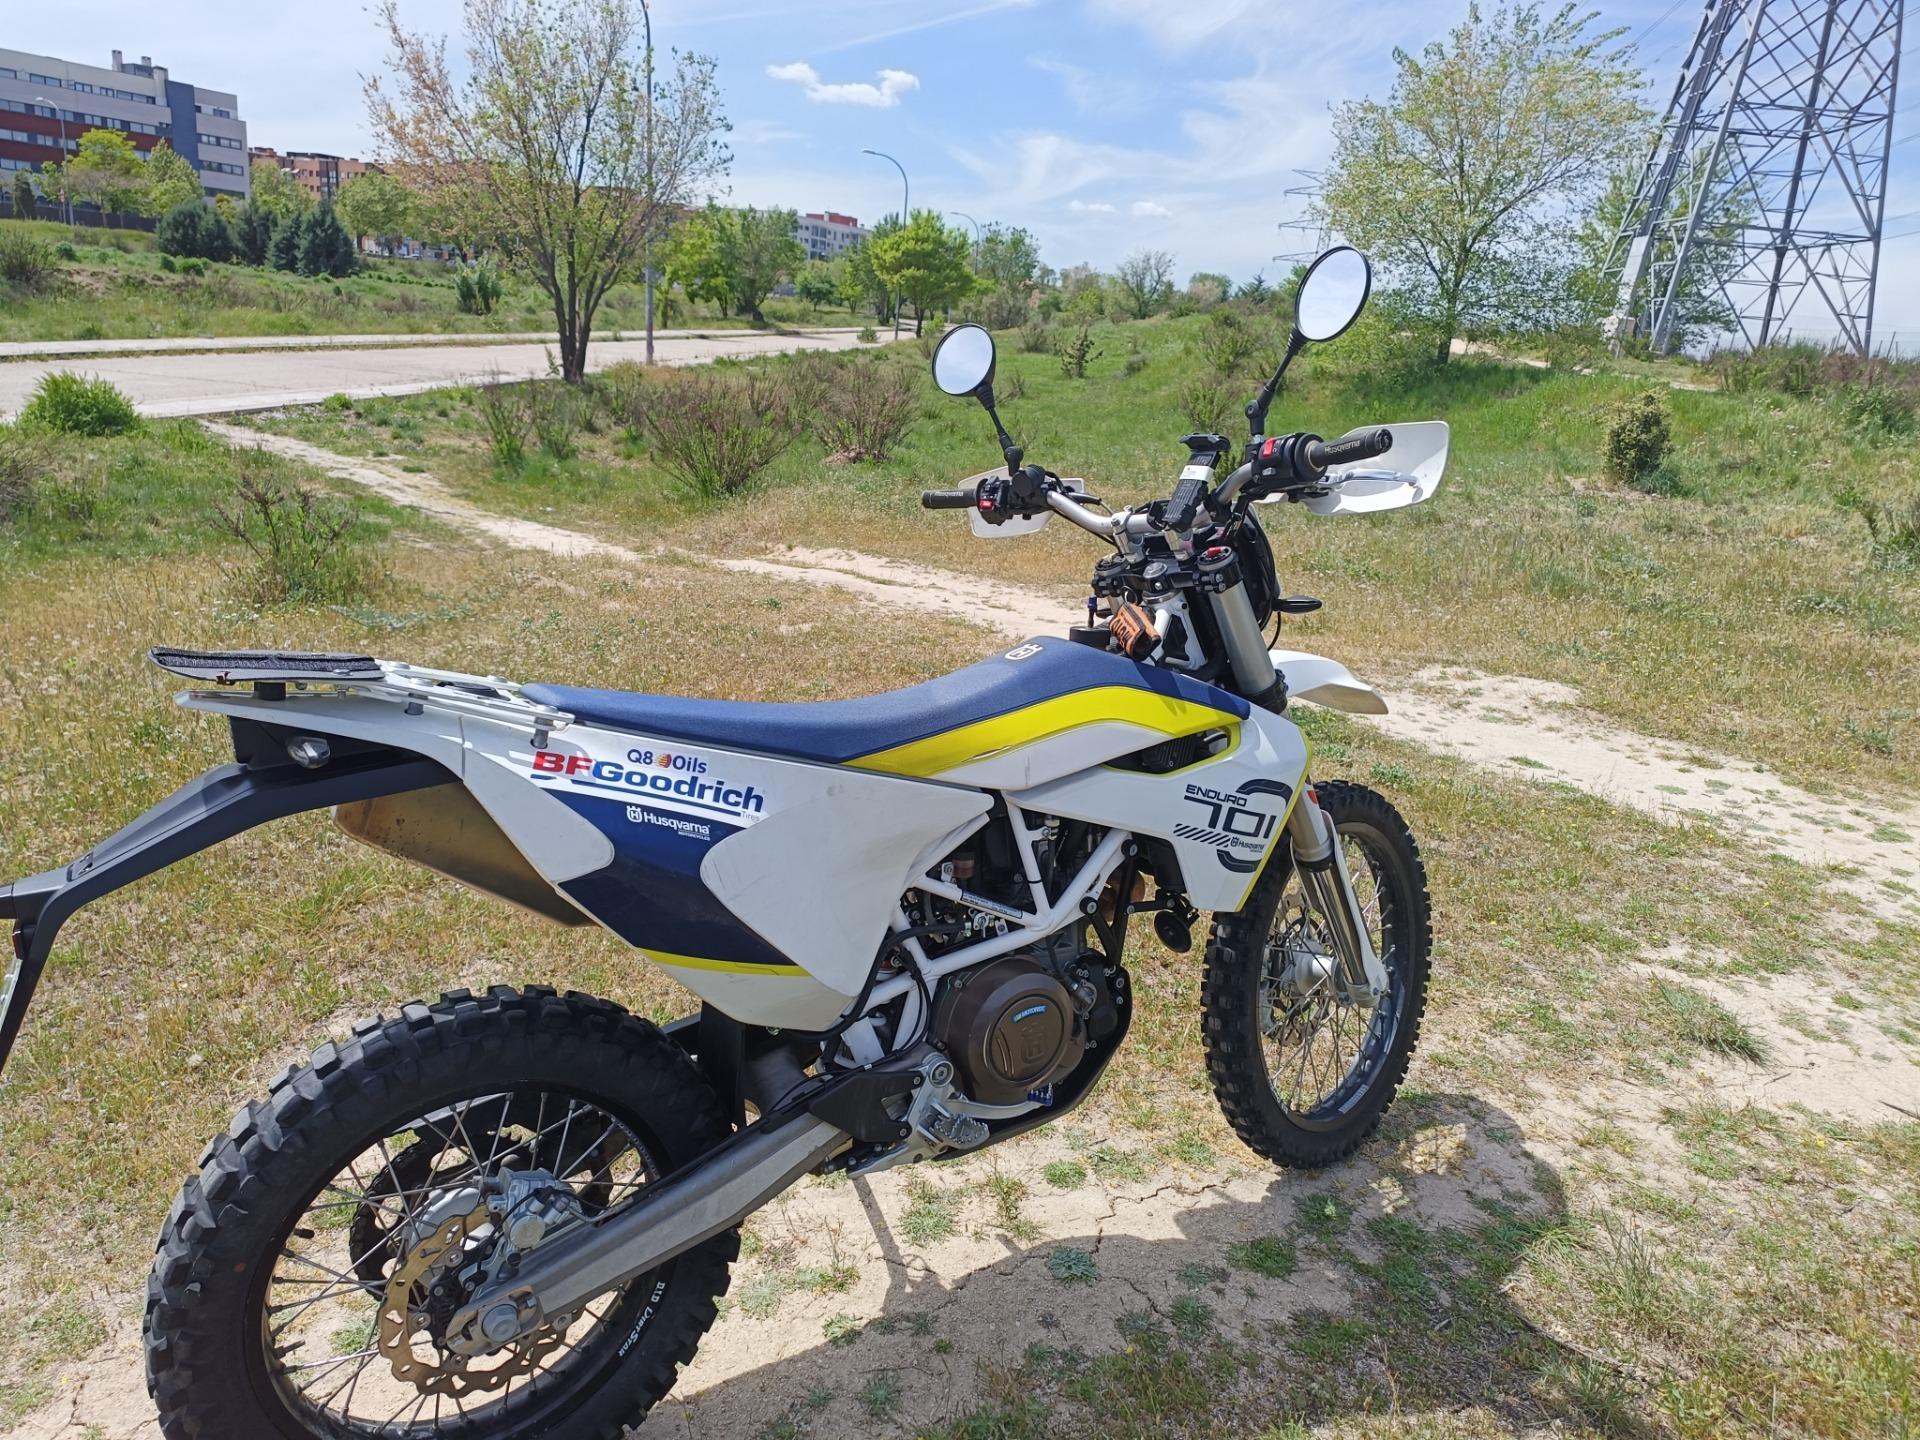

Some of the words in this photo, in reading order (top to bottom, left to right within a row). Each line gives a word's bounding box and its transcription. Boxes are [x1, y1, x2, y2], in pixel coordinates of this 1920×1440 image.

[627, 748, 653, 766] Q8
[672, 755, 707, 774] Oils
[532, 750, 765, 813] BFGoodrich
[1186, 784, 1248, 807] ENDURO
[643, 811, 711, 835] Husqvarna
